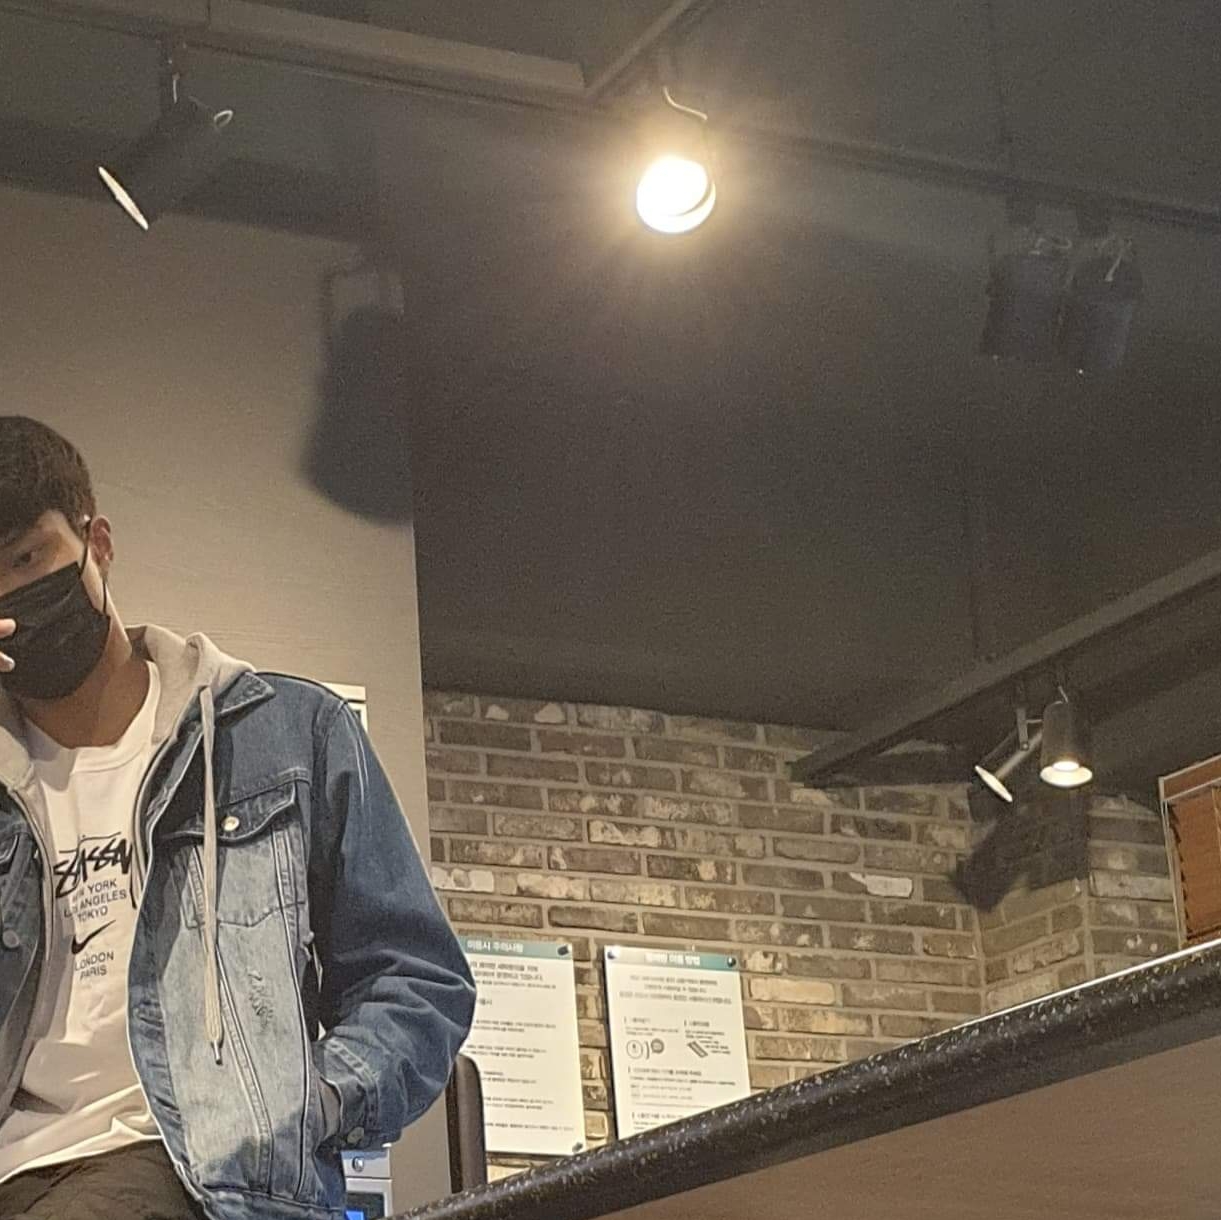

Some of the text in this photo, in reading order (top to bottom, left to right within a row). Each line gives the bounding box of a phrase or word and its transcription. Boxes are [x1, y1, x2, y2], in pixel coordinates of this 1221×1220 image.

[87, 879, 117, 895] YORK
[80, 889, 127, 909] ANGELES
[77, 906, 108, 922] TOKYO
[74, 951, 114, 972] LONDON
[80, 965, 108, 982] PARIS
